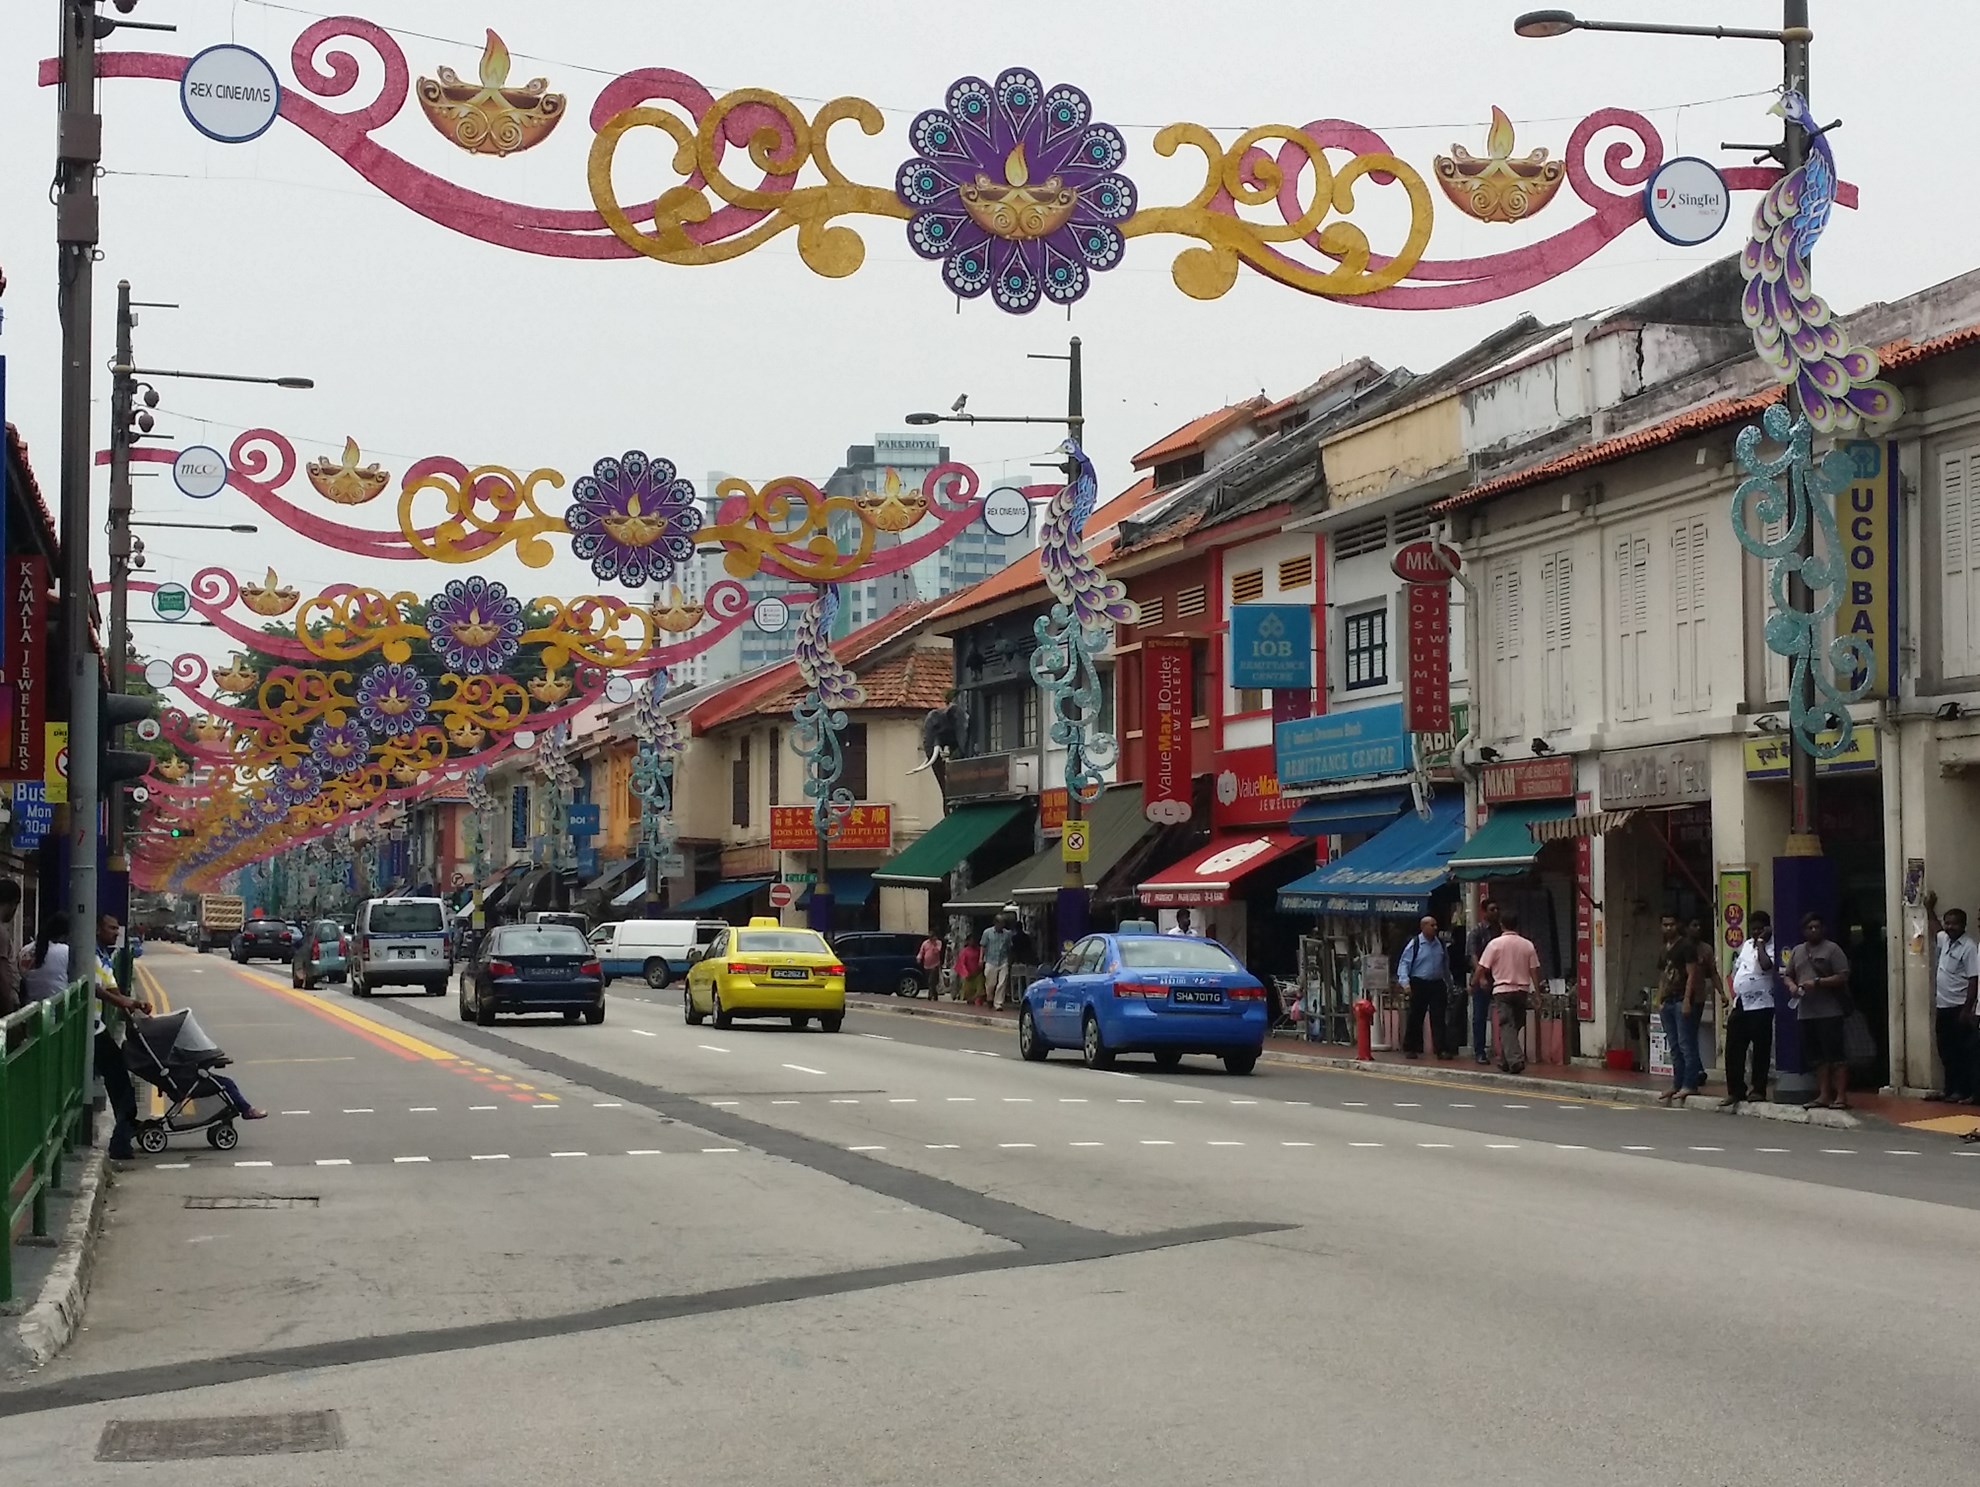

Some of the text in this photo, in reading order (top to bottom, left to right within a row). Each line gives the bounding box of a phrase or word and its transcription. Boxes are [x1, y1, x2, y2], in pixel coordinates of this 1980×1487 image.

[191, 82, 270, 102] REX CINEMAS
[1679, 193, 1719, 207] SingTel
[1851, 488, 1874, 570] UCO
[17, 562, 34, 771] KAMALA JEWELLERS
[1413, 588, 1428, 696] COSTUME
[1429, 607, 1445, 728] JEWELLERY
[1172, 656, 1182, 751] JEWELLERY
[1285, 746, 1395, 777] REMITTANCE CENTRE
[1485, 767, 1515, 797] MKM
[1175, 991, 1221, 1002] SHA7017G
